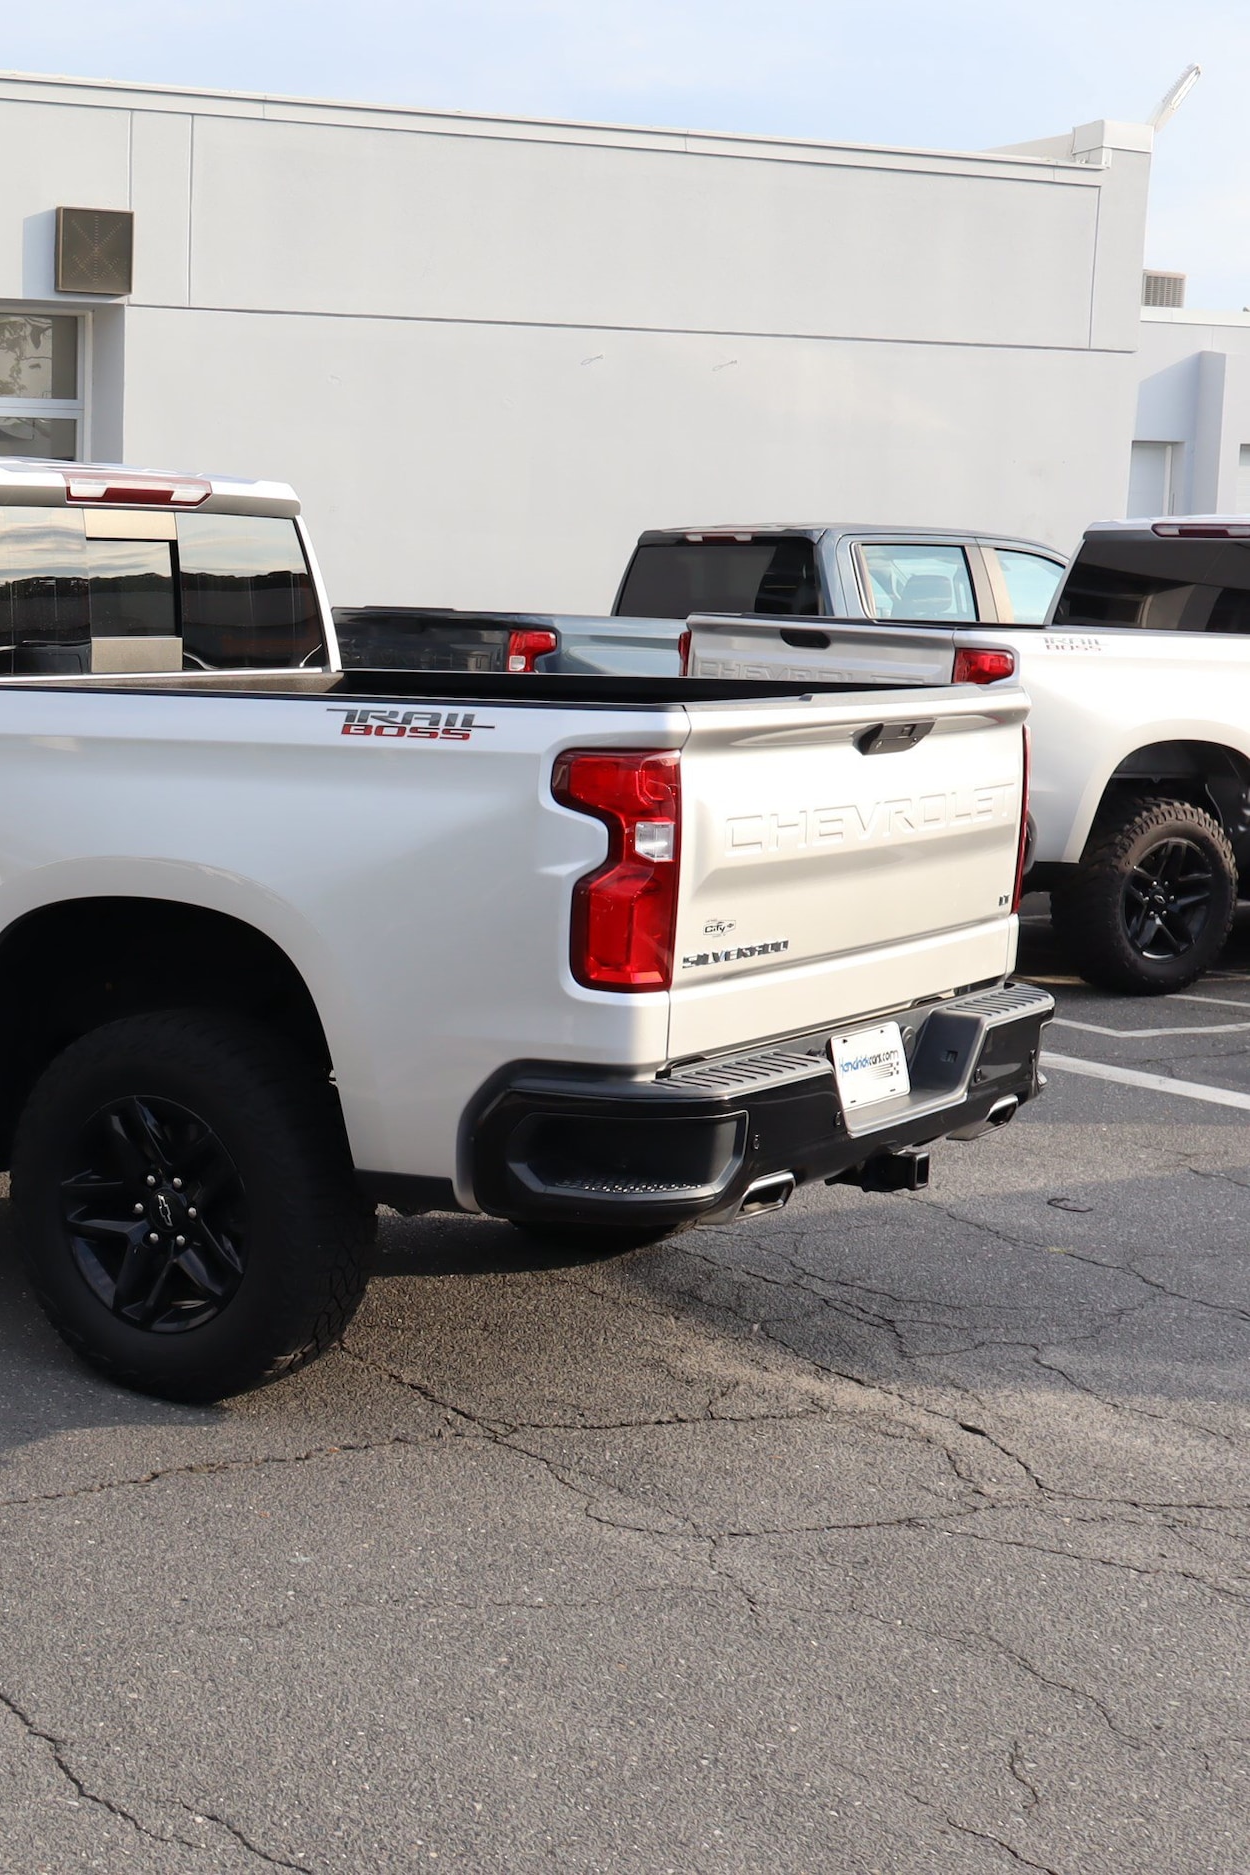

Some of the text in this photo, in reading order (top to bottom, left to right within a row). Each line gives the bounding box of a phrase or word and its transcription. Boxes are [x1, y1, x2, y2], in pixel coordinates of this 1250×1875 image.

[326, 708, 495, 729] TRAIL
[341, 723, 472, 741] BOSS
[725, 782, 1015, 857] CHEVROLET
